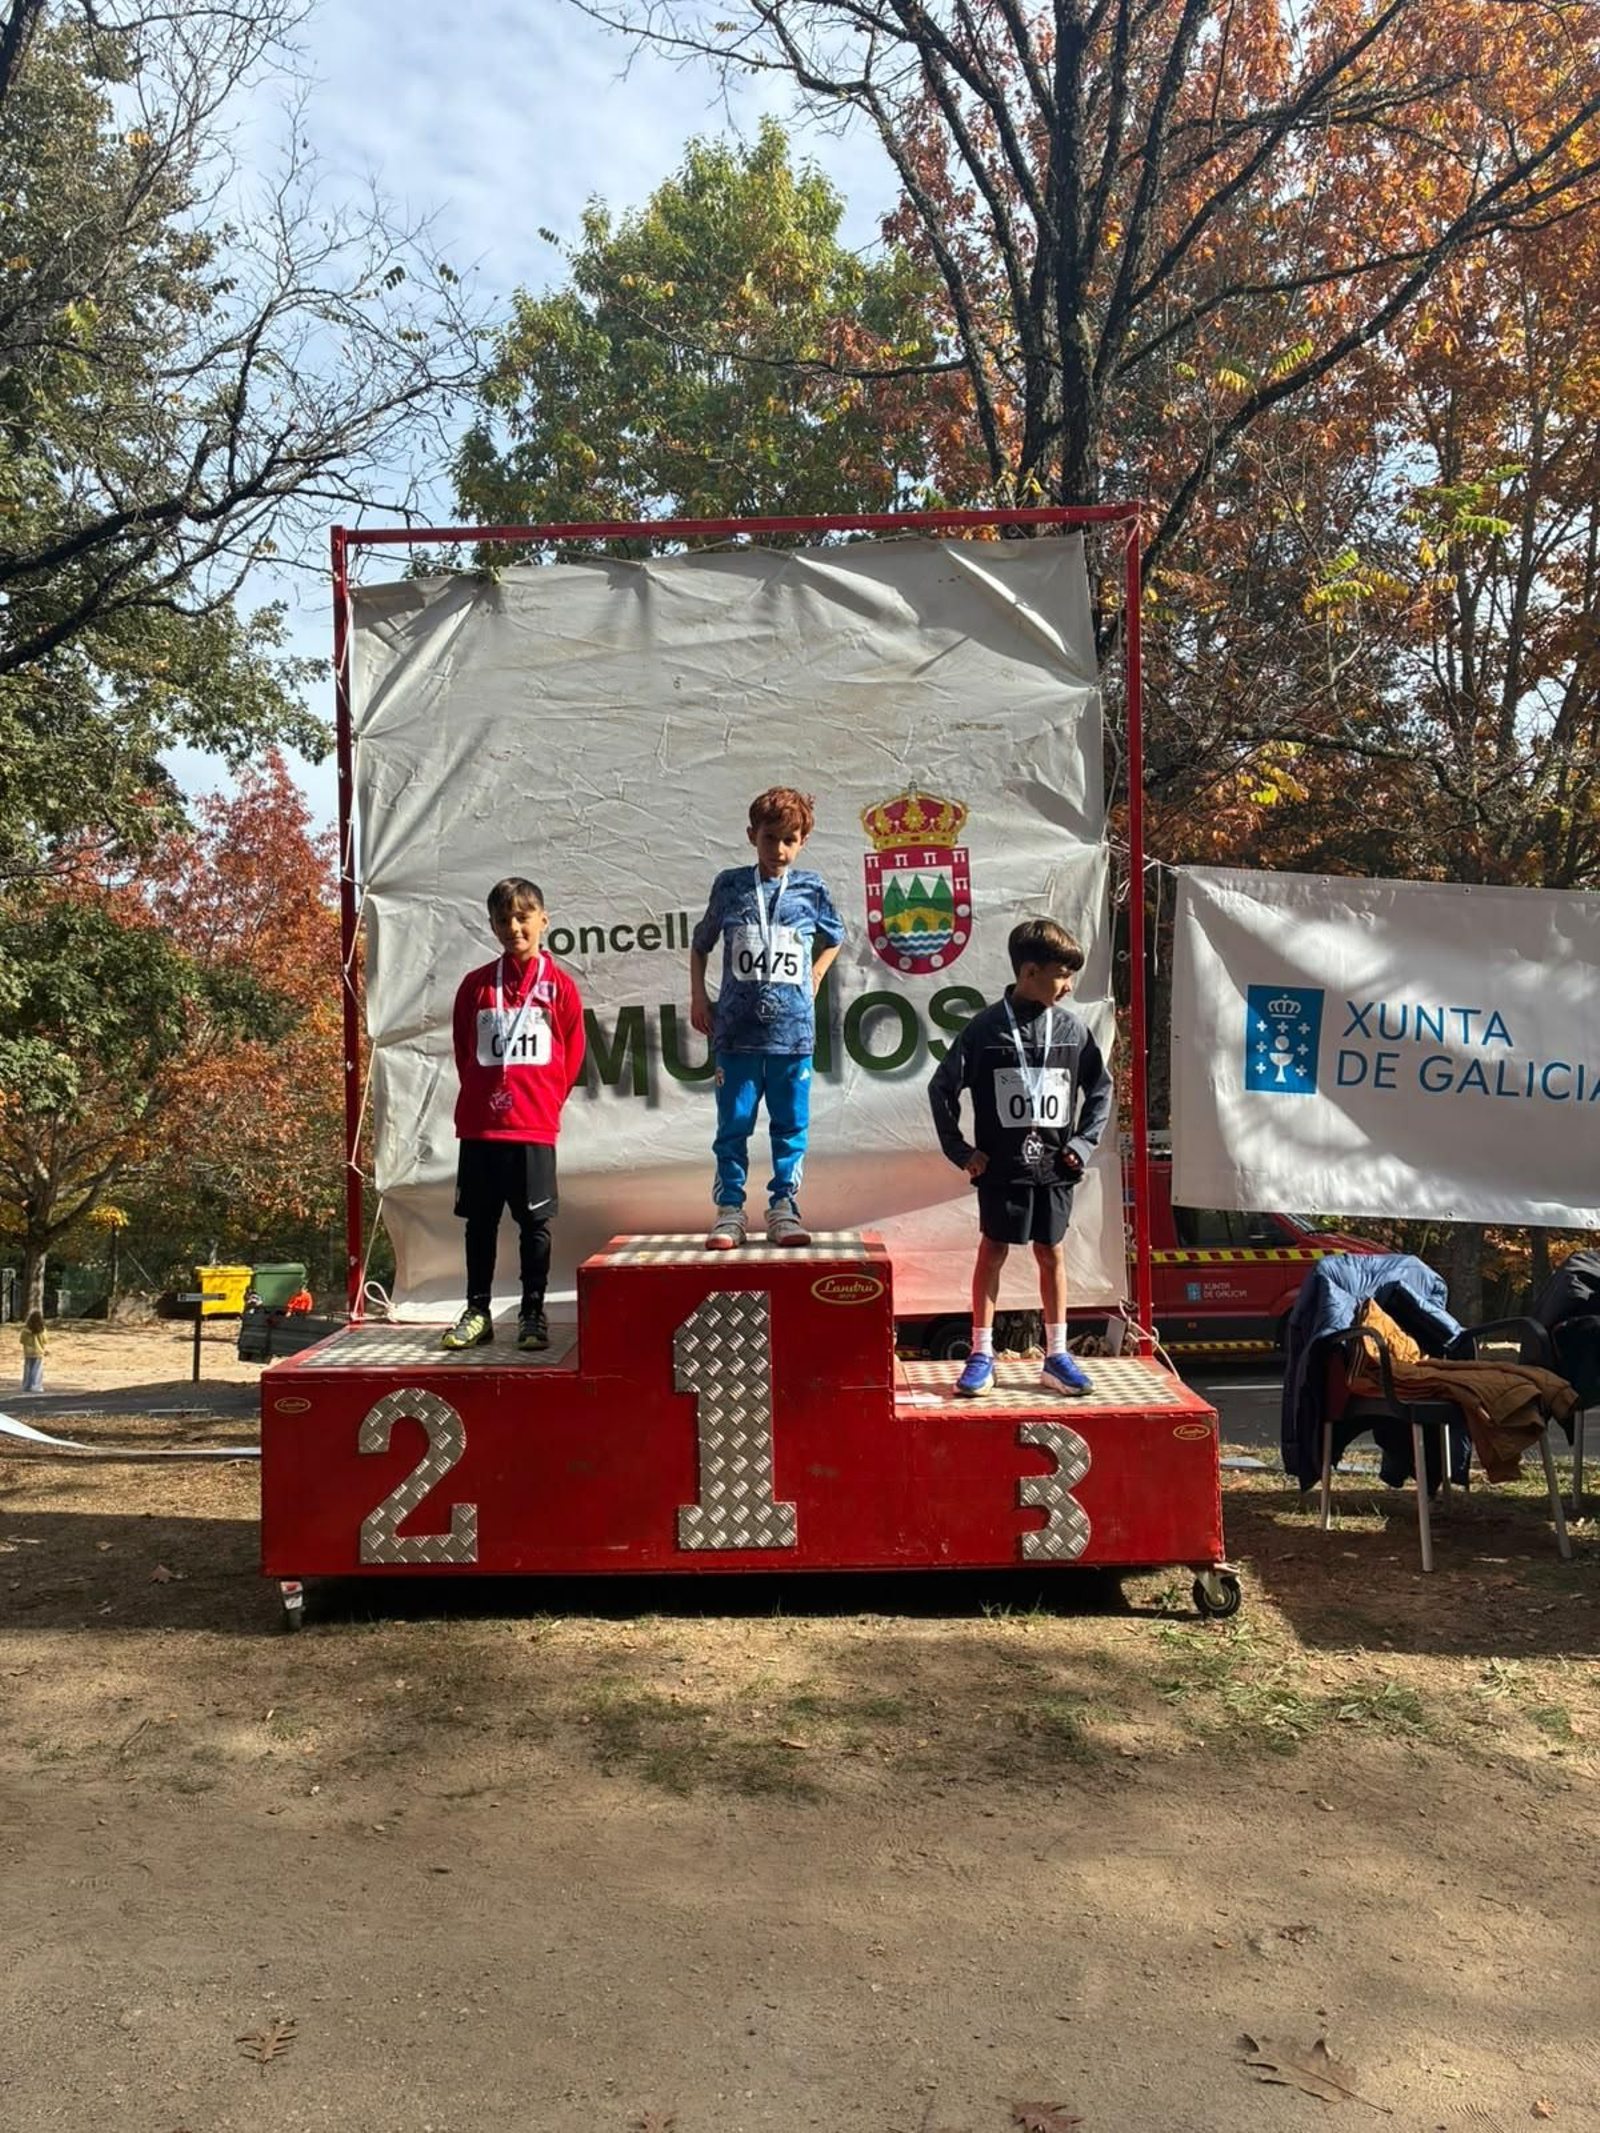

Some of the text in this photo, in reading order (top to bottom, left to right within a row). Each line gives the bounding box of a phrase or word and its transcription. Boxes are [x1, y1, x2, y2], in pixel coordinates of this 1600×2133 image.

[541, 911, 692, 955] oncell
[738, 949, 798, 976] 0475
[1343, 1000, 1514, 1047] XUNTA
[1336, 1049, 1400, 1089] DE
[673, 1290, 797, 1549] 1
[358, 1387, 477, 1564] 2
[1020, 1421, 1092, 1561] 3
